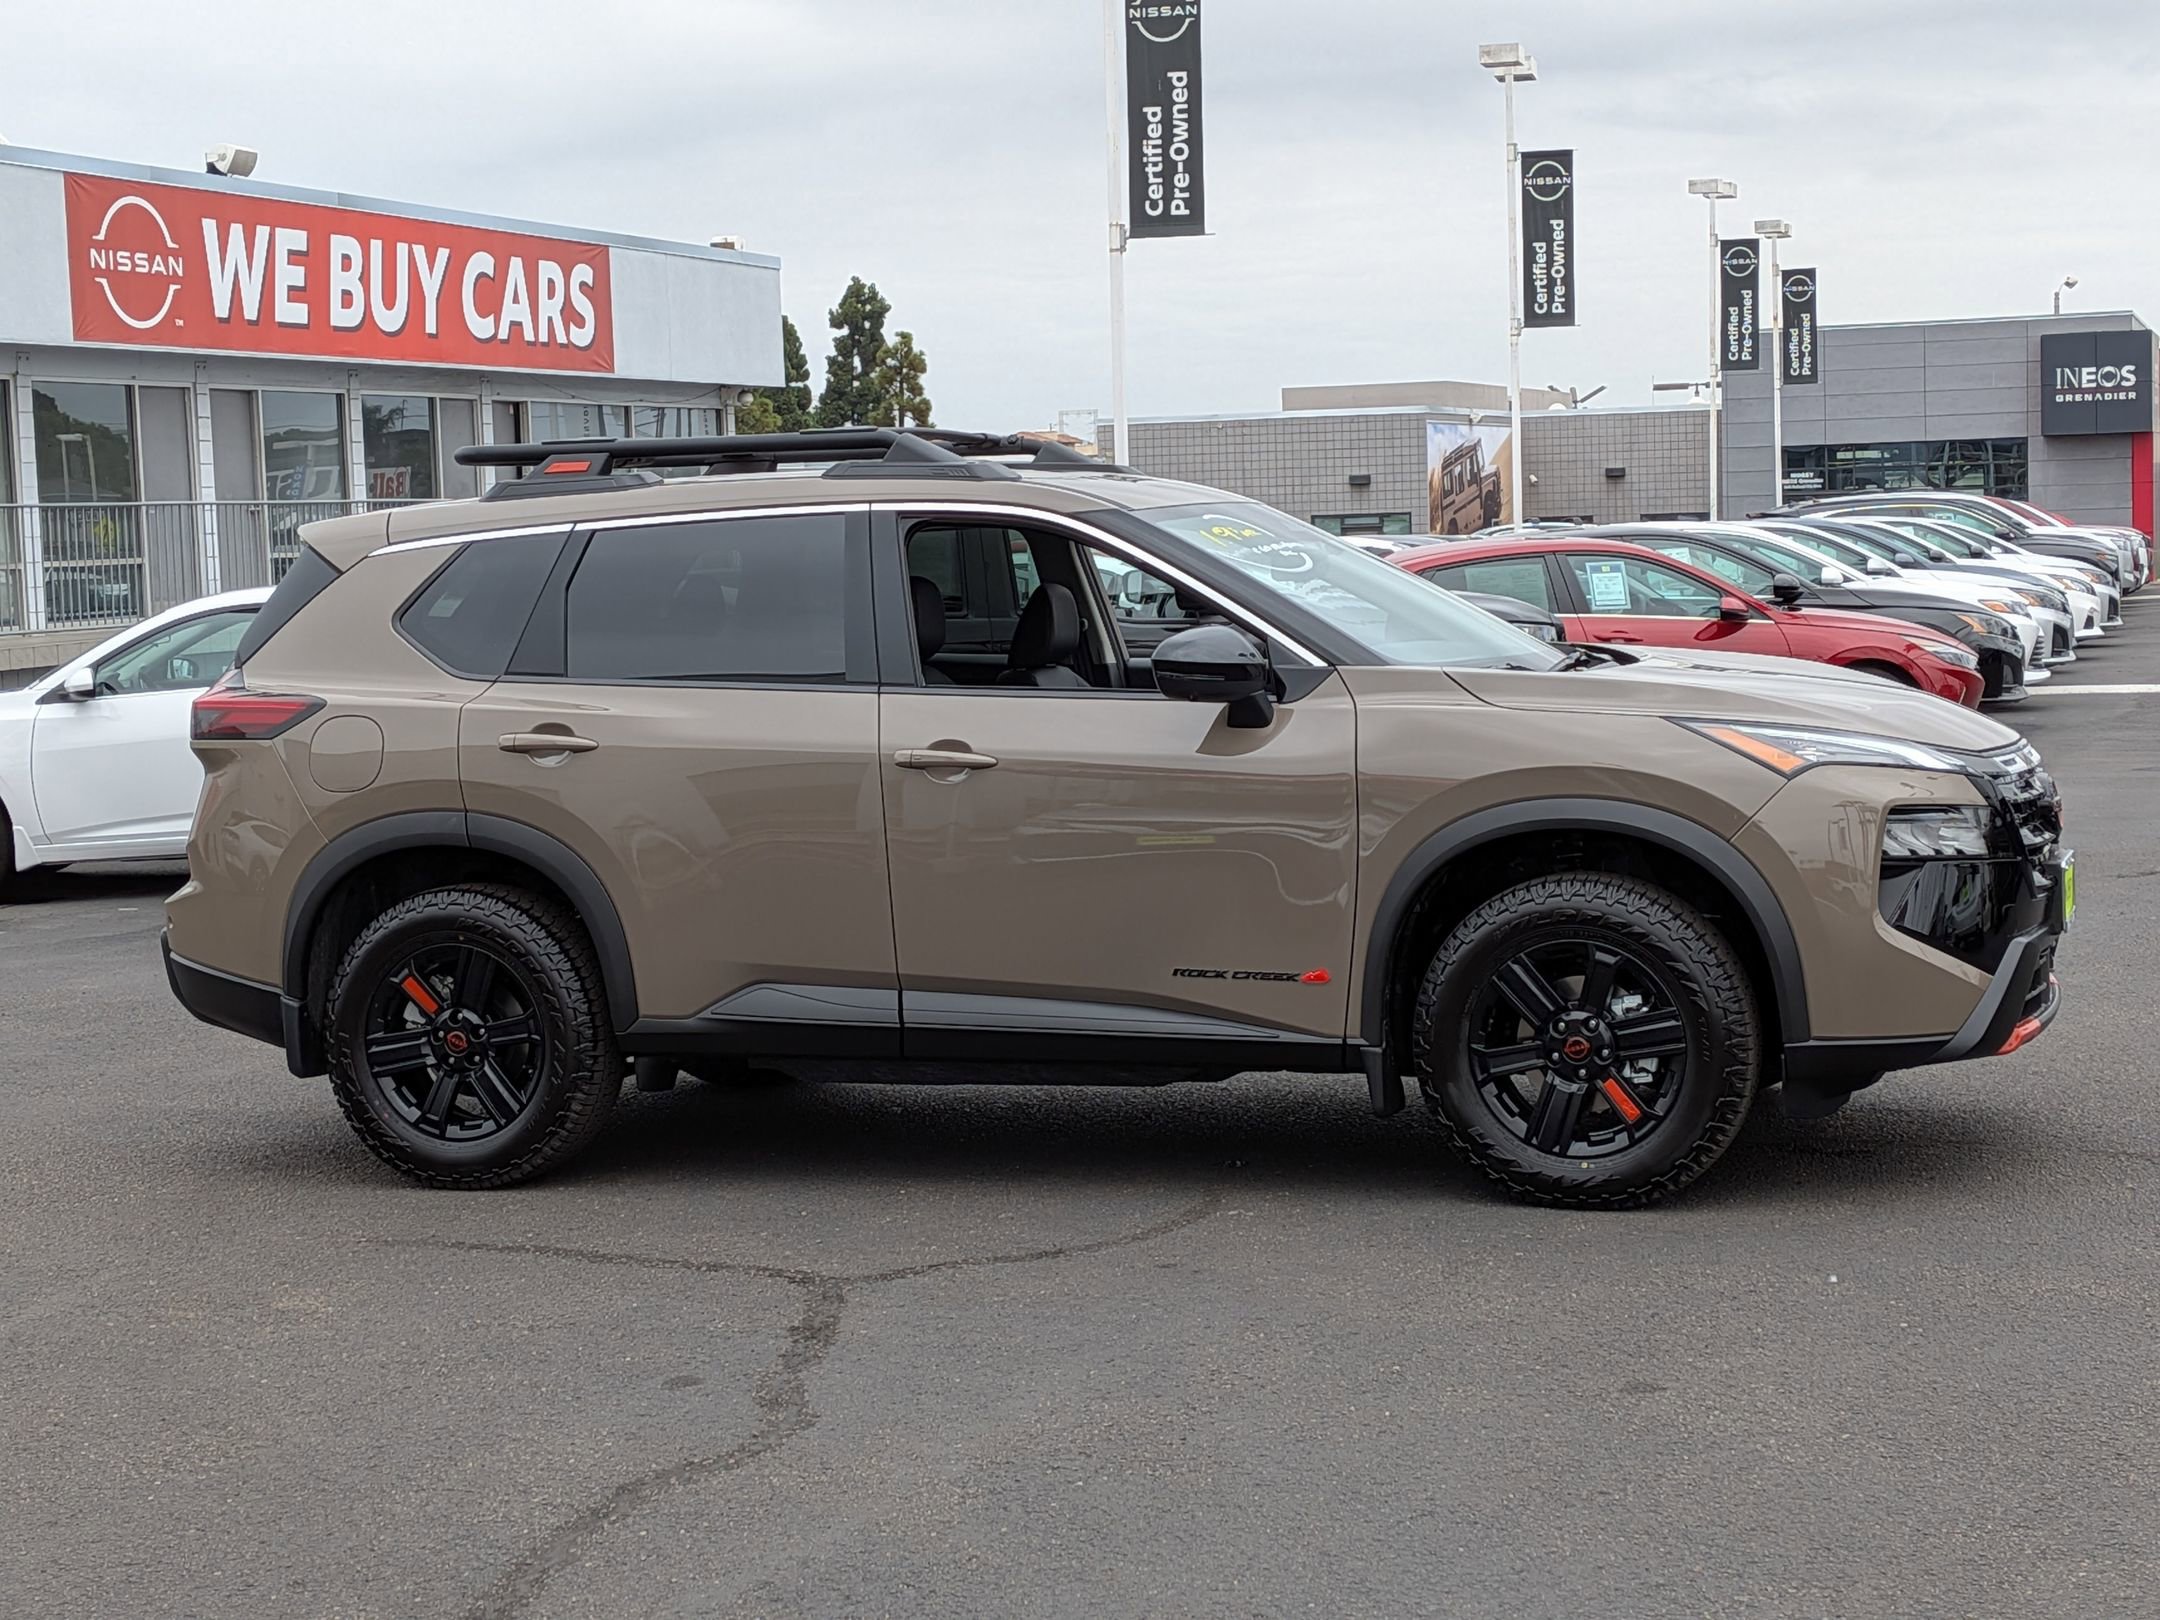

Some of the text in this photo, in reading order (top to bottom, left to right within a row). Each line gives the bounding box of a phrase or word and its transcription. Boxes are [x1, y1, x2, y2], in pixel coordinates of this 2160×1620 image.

[1129, 4, 1197, 18] NISSAN
[1142, 106, 1164, 216] Certified
[1167, 71, 1190, 215] Pre-Owned
[1524, 177, 1571, 185] NISSAN
[89, 248, 184, 277] NISSAN
[201, 217, 596, 349] WE BUY CARS
[1532, 242, 1547, 314] Certified
[1550, 219, 1566, 314] Pre-Owned
[1728, 307, 1739, 361] Certified
[1741, 290, 1752, 360] Pre-Owned
[1789, 328, 1800, 376] Certified
[1800, 313, 1811, 376] Pre-Owned
[2055, 365, 2137, 389] INEOS
[2055, 392, 2137, 402] GRENADIER
[1172, 968, 1300, 982] ROCK CREEK
